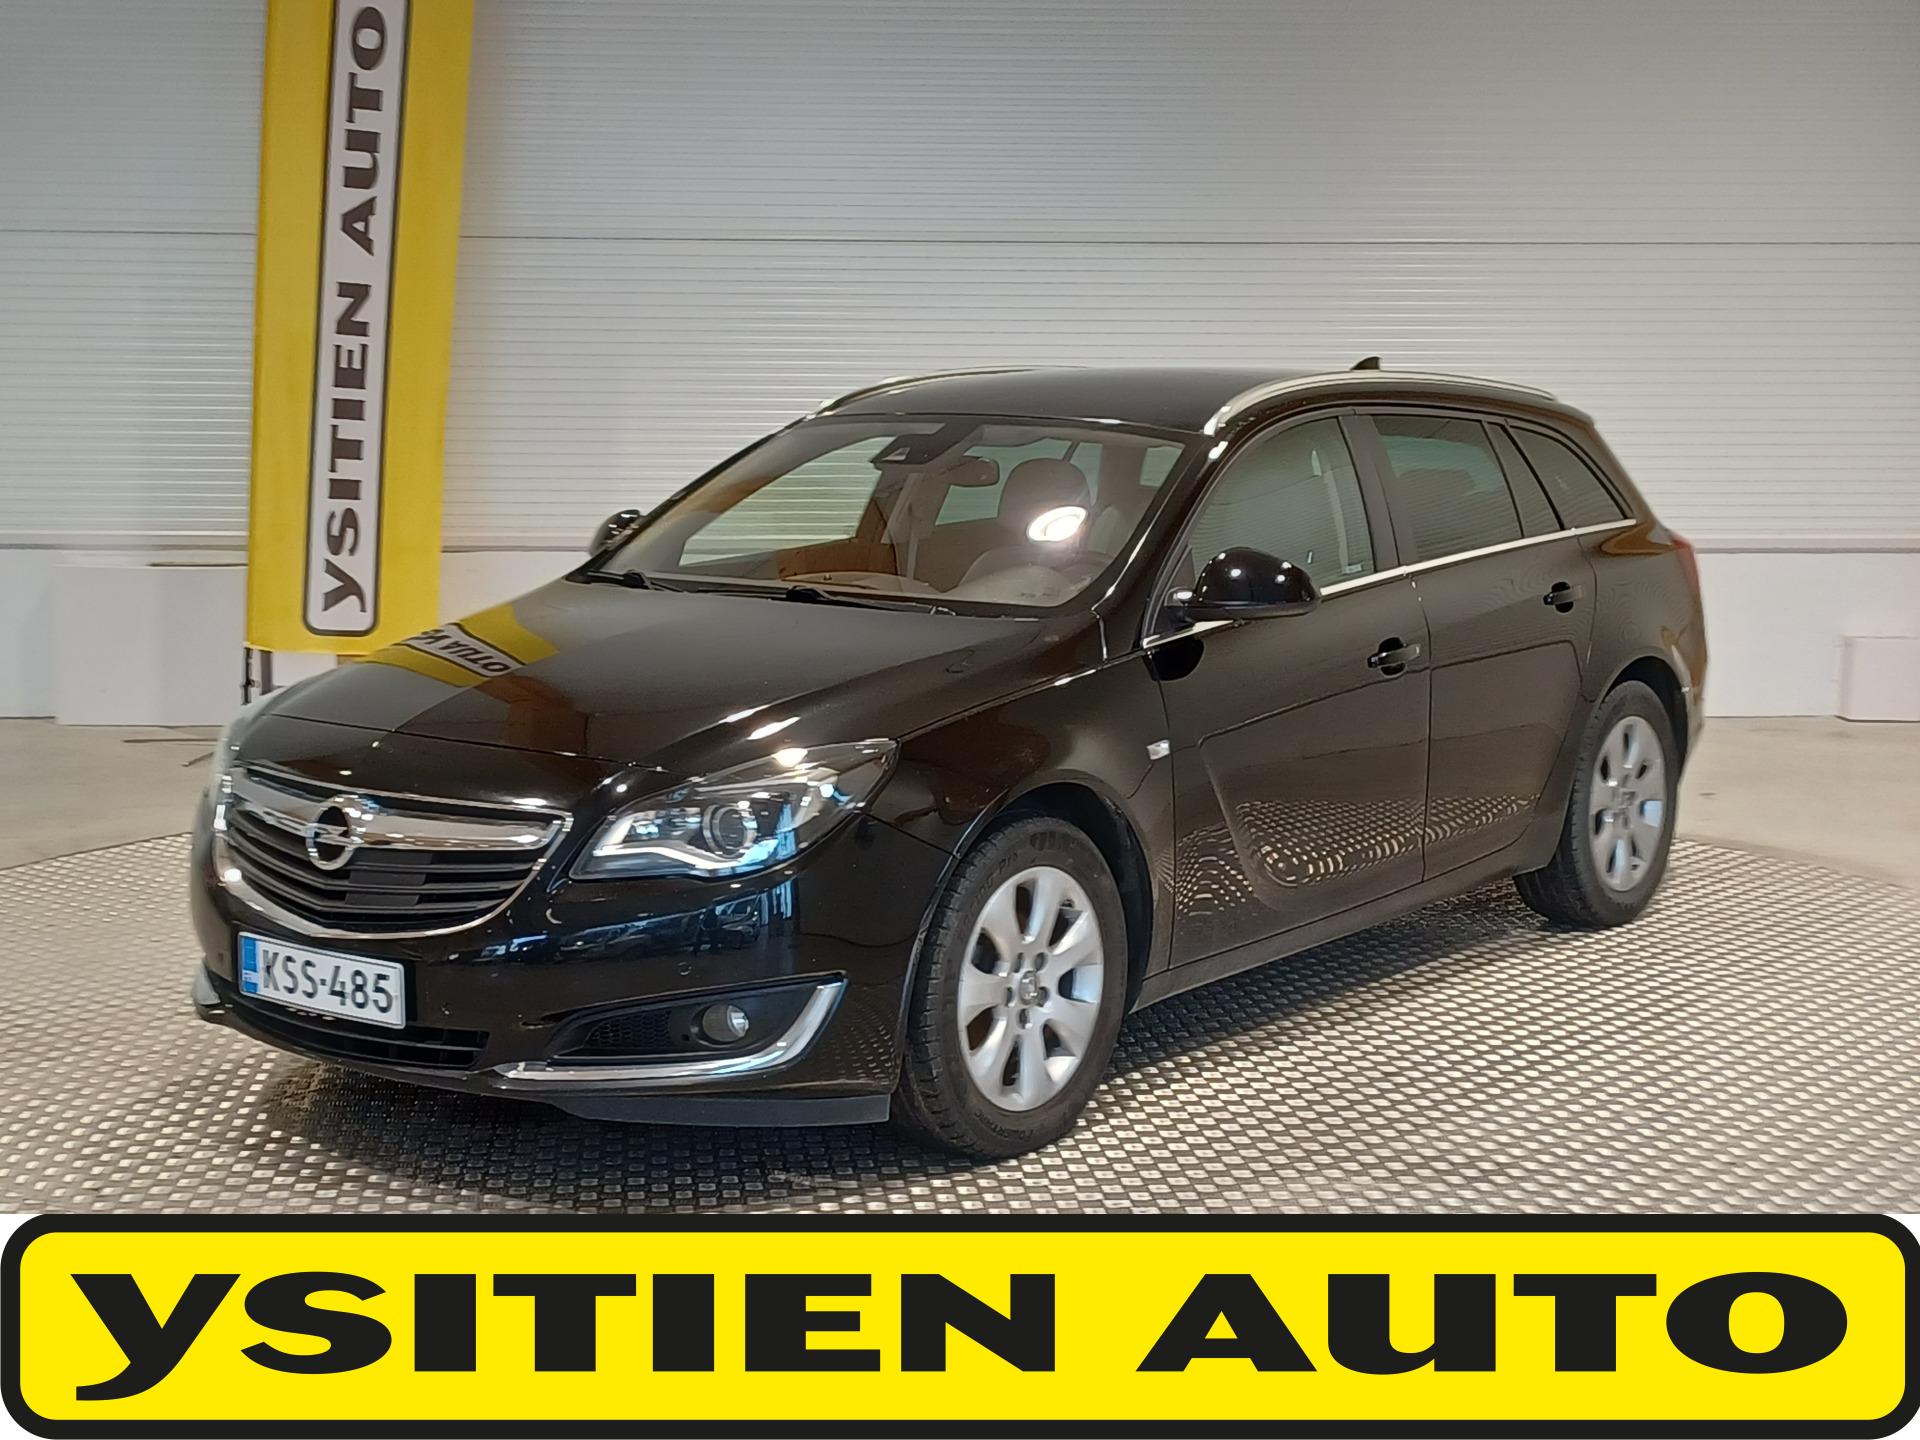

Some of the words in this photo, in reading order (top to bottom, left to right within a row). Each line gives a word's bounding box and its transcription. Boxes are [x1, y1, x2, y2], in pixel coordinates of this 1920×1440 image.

[341, 6, 387, 256] AUTO
[322, 282, 372, 613] YSITIEN
[262, 949, 393, 1013] KSS-485
